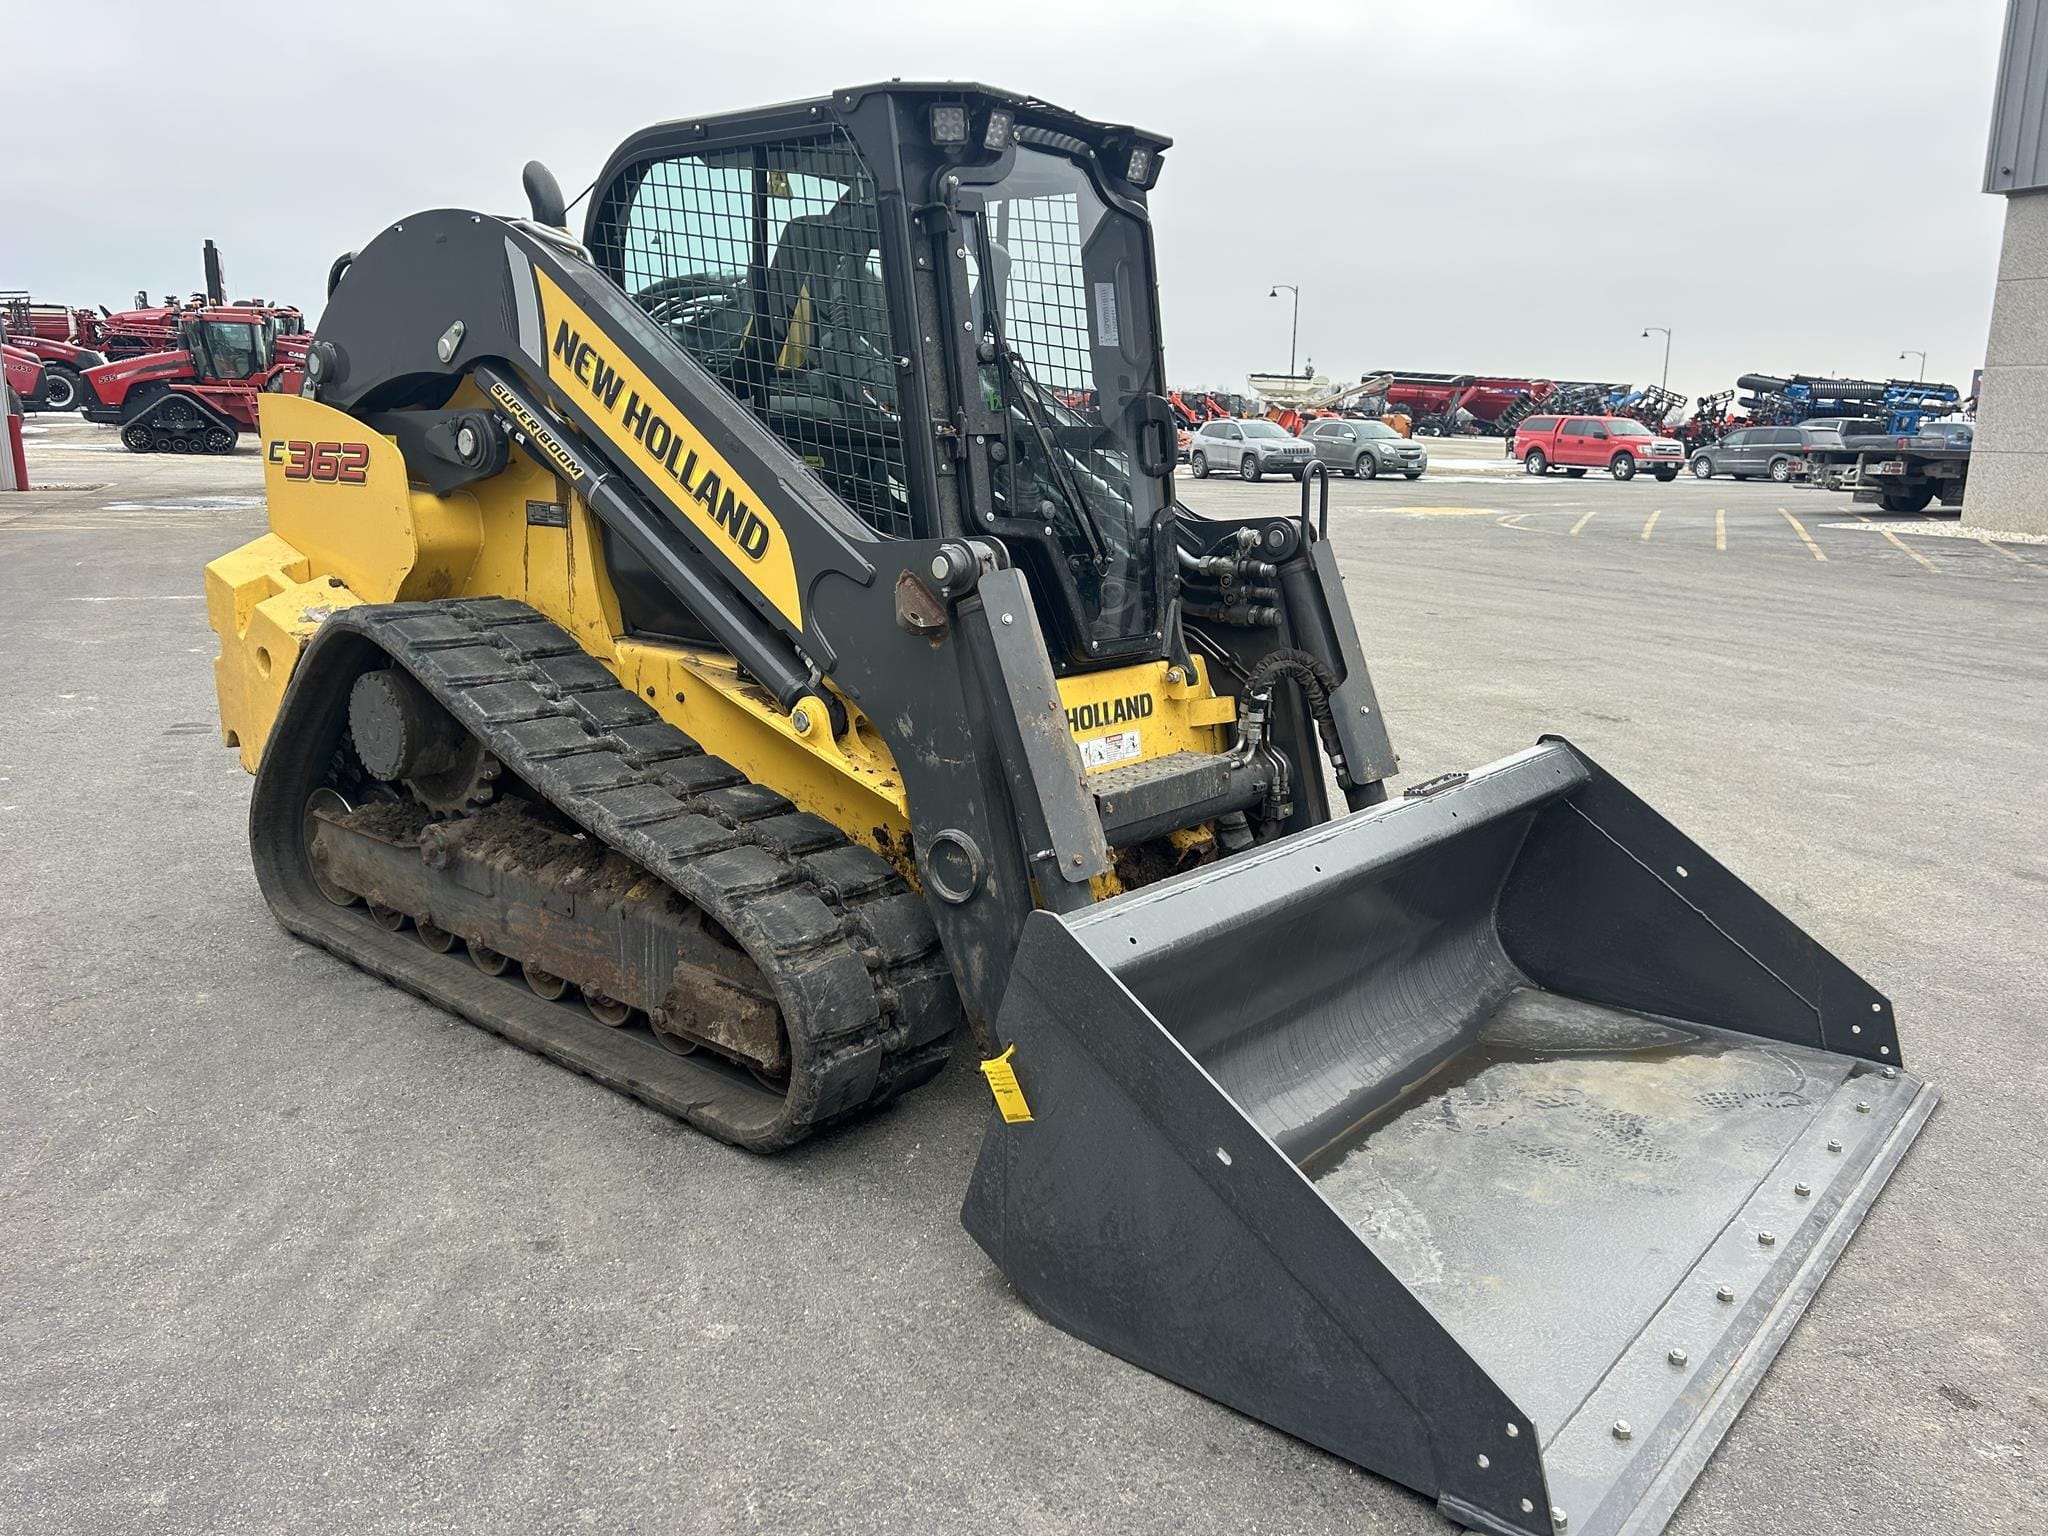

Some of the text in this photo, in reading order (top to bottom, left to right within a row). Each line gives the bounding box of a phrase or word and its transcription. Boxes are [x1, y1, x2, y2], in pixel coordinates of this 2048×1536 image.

[491, 382, 542, 437] SUPER
[536, 430, 585, 480] BOOM
[552, 319, 770, 563] NEW HOLLAND
[1064, 692, 1153, 732] HOLLAND
